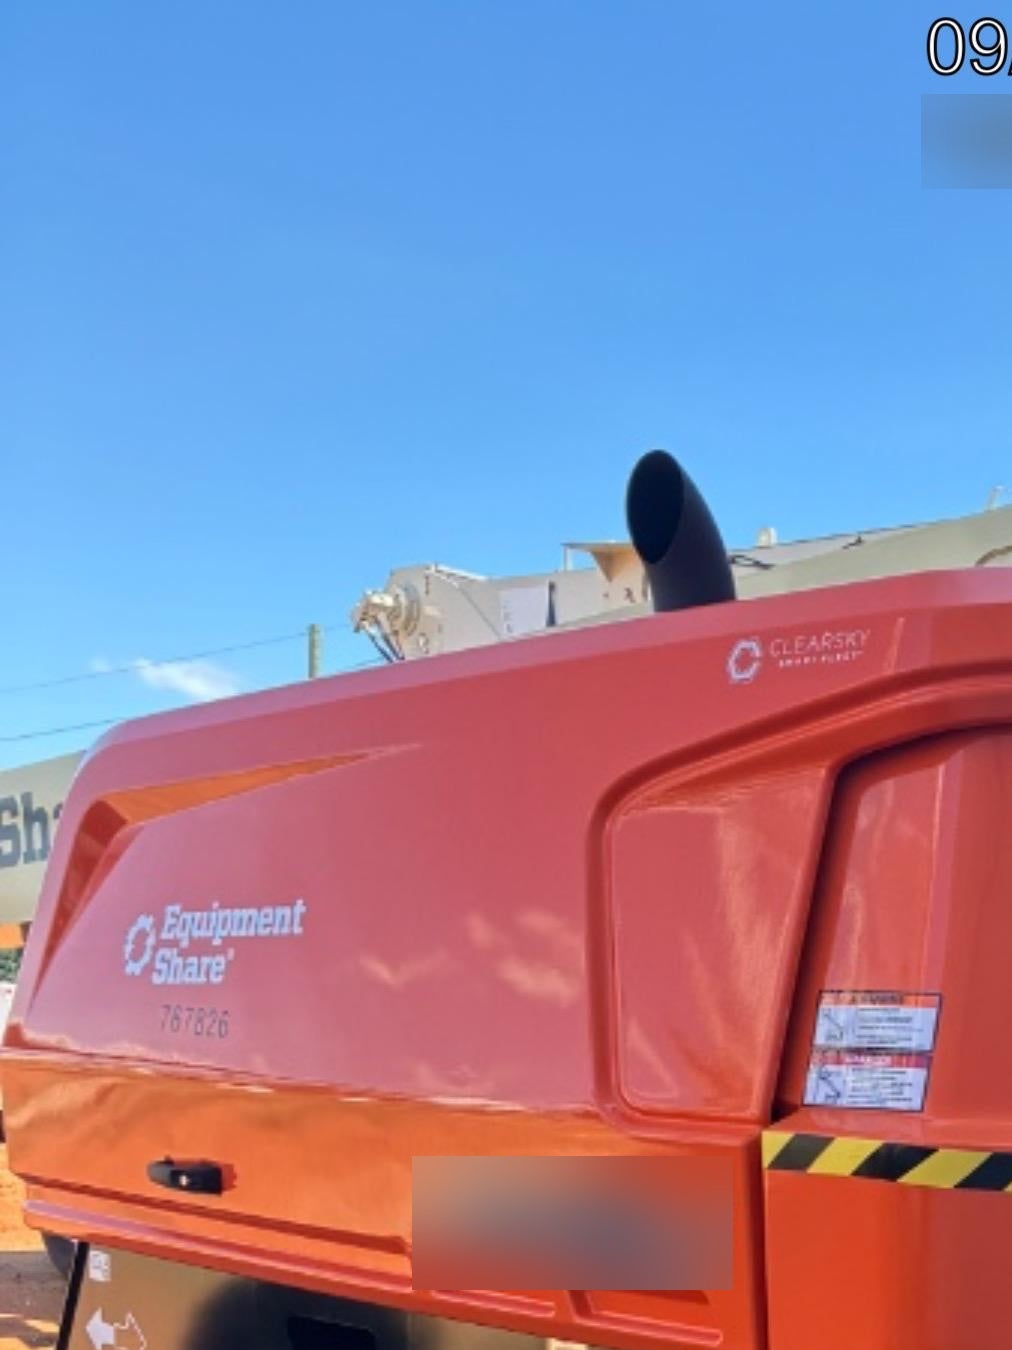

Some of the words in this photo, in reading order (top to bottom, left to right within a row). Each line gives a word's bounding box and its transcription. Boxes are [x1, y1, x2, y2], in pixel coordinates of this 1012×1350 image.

[769, 629, 871, 657] CLEARSKY
[159, 898, 307, 949] Equipment
[160, 1003, 231, 1039] 767826
